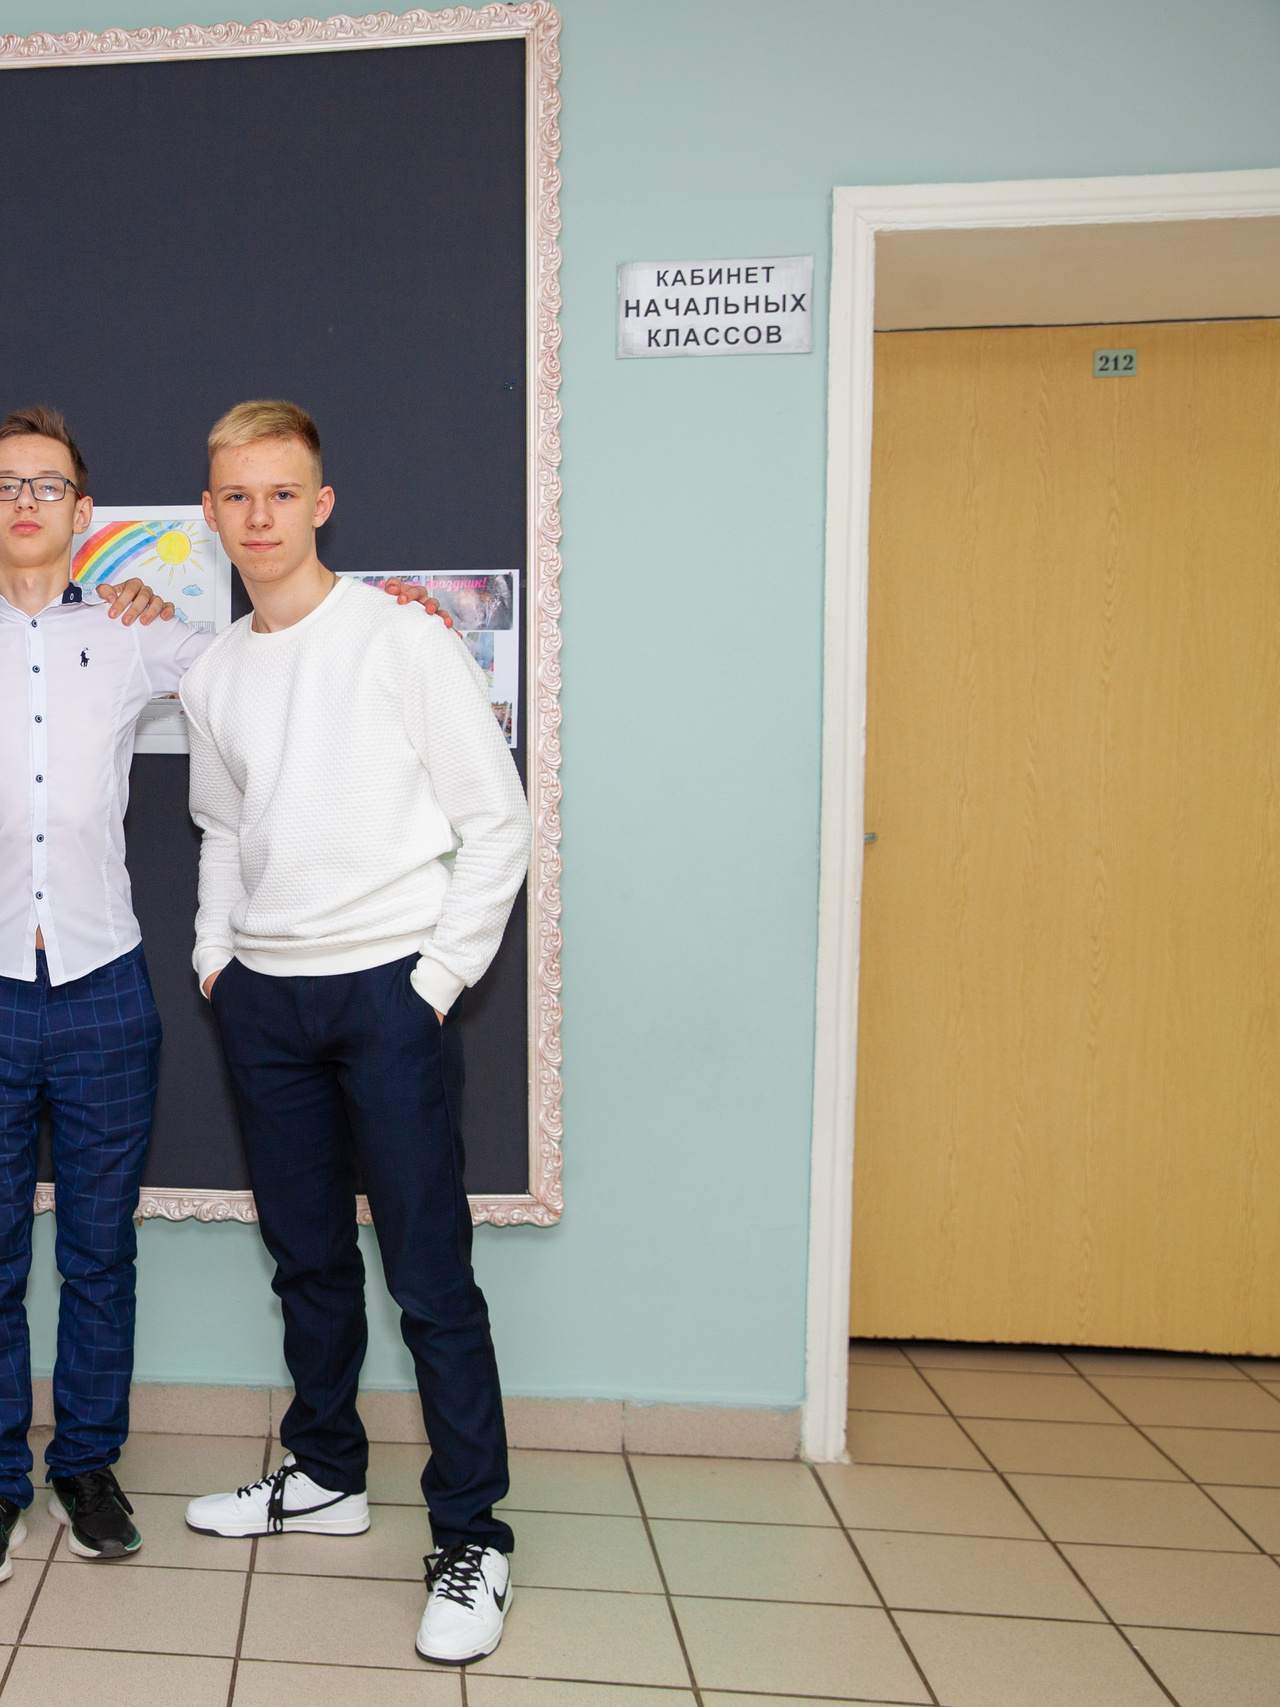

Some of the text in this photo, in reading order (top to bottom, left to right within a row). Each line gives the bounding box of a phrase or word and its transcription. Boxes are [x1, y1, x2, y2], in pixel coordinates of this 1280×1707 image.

[656, 266, 775, 287] КАБИНЕТ
[624, 293, 807, 318] НАЧАЛЬНЫХ
[647, 325, 783, 348] КЛАССОВ
[1098, 354, 1134, 372] 212
[424, 576, 488, 592] праздник!
